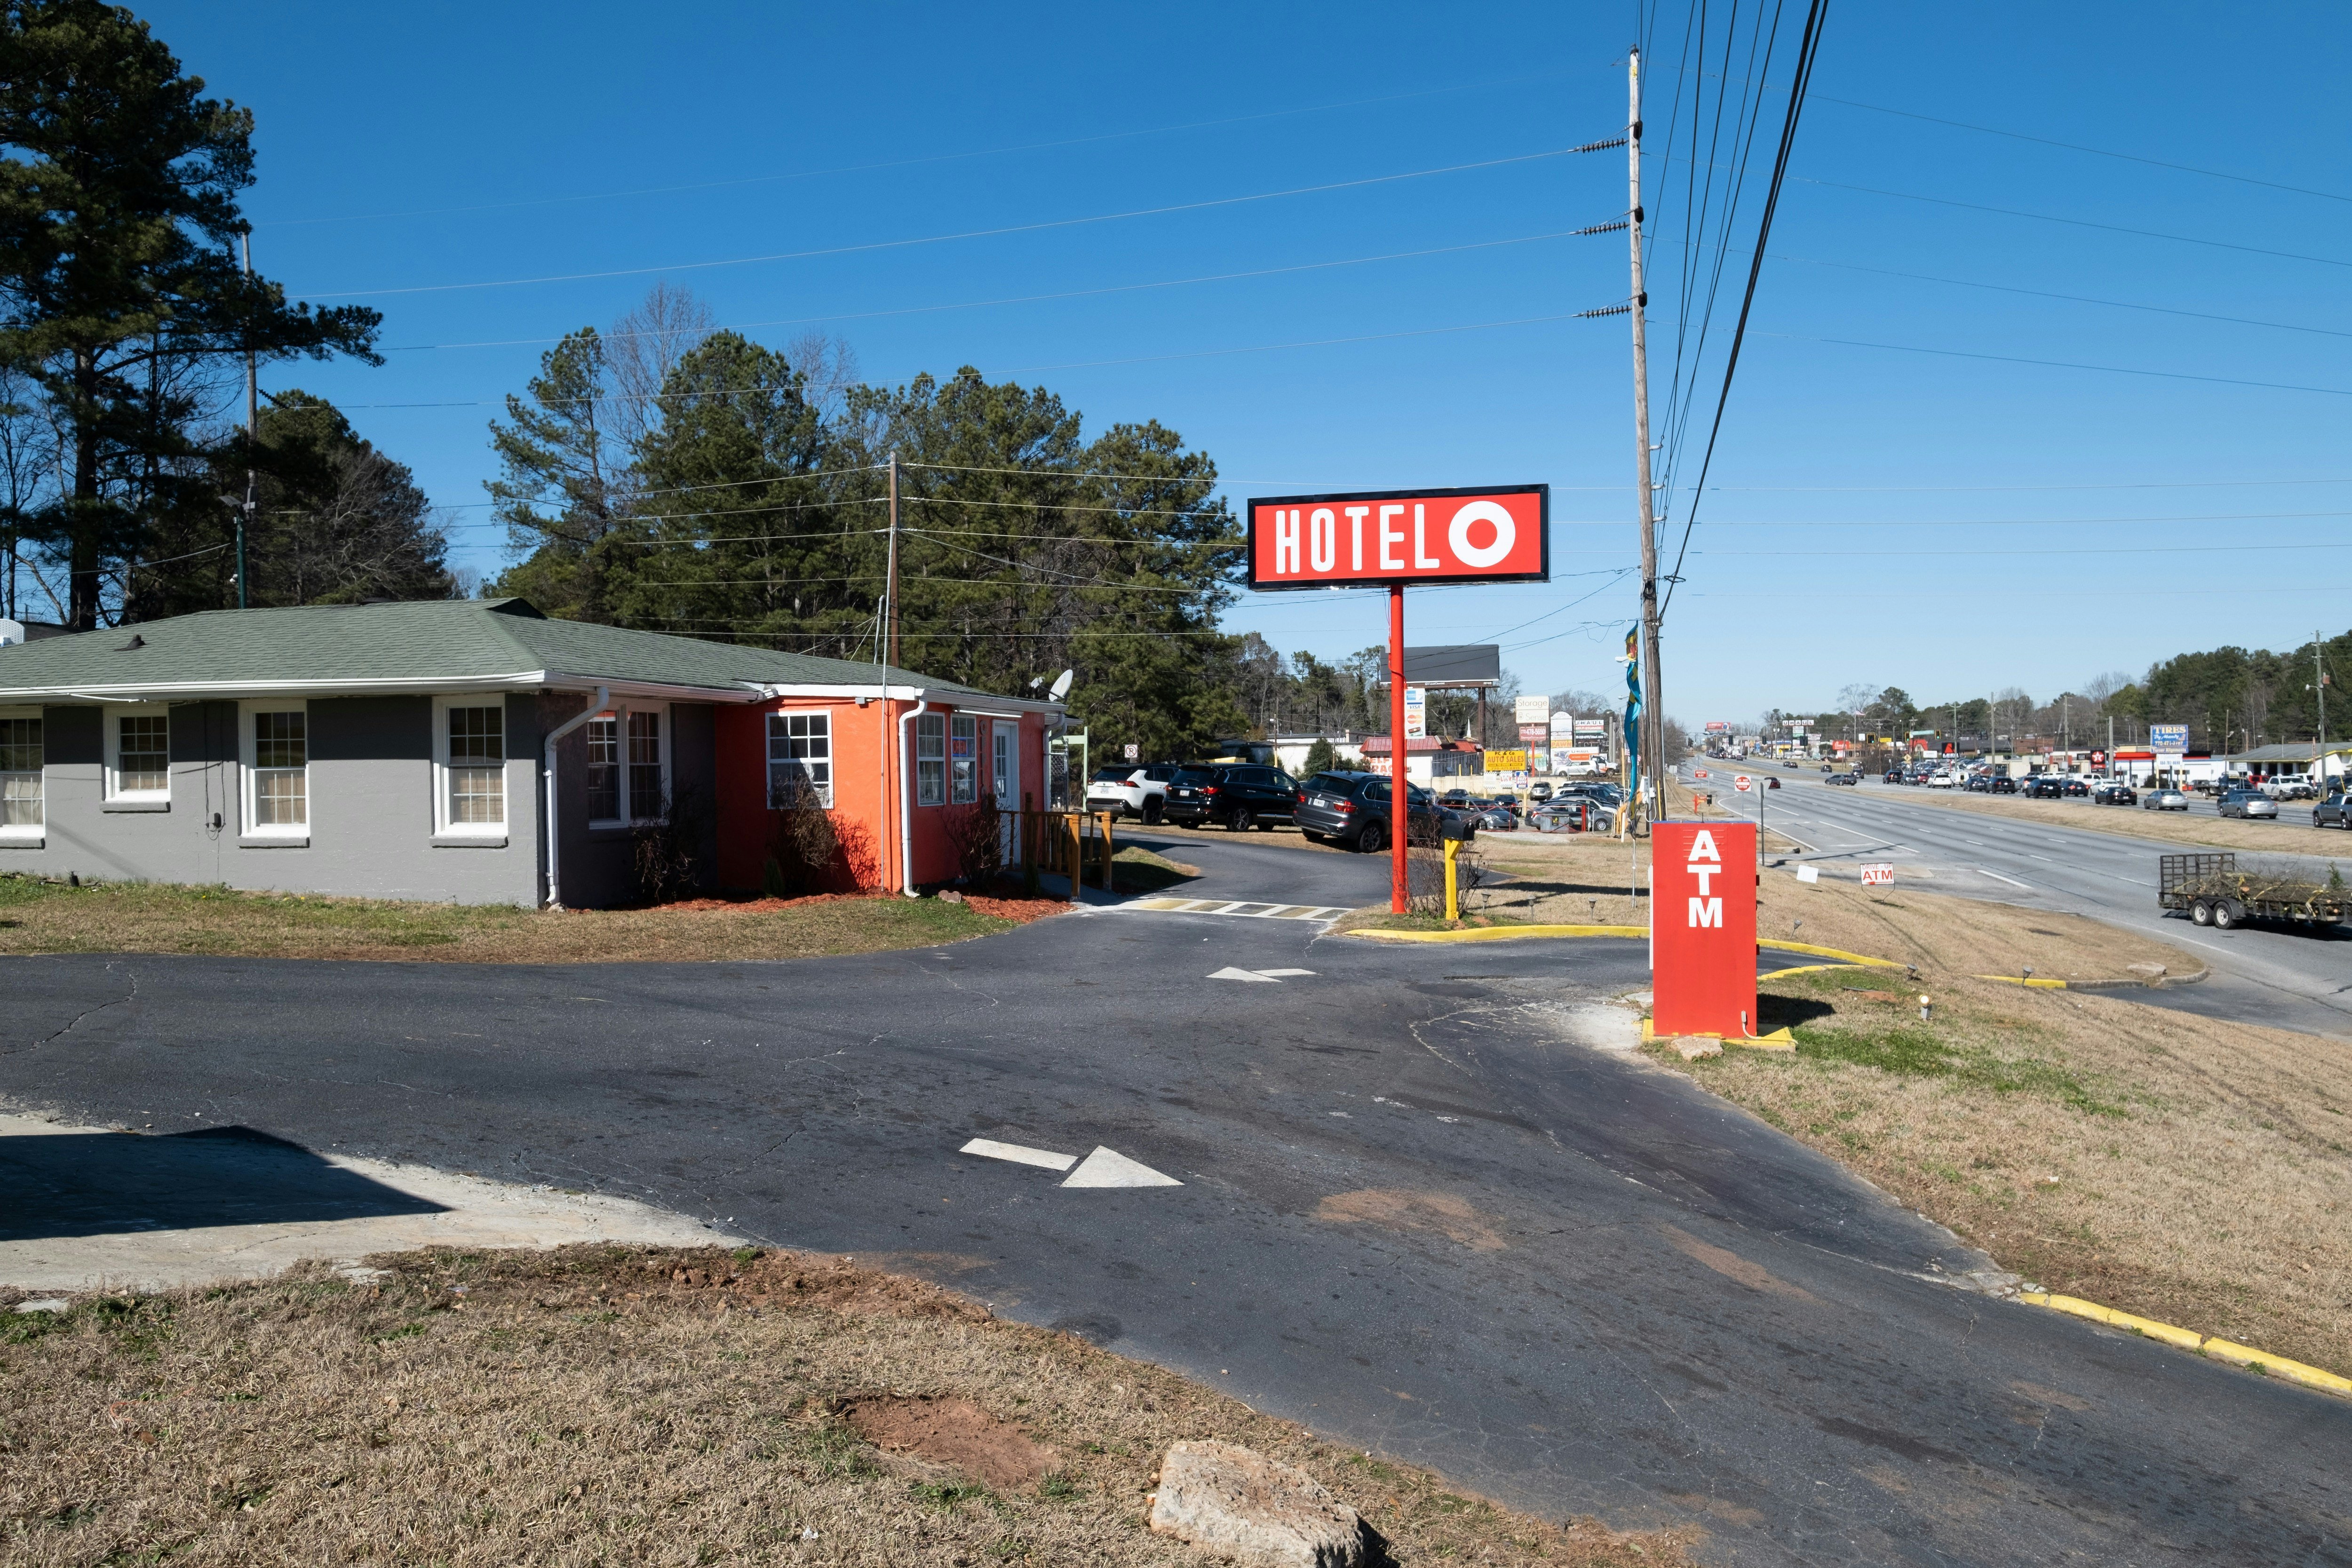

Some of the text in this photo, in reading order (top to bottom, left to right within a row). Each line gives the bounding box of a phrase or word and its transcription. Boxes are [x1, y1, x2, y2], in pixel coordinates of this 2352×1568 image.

[1276, 500, 1516, 574] HOTEL O
[1518, 699, 1547, 708] Storage
[953, 740, 966, 753] OPEN
[1687, 830, 1723, 928] ATM
[1863, 870, 1892, 880] ATM
